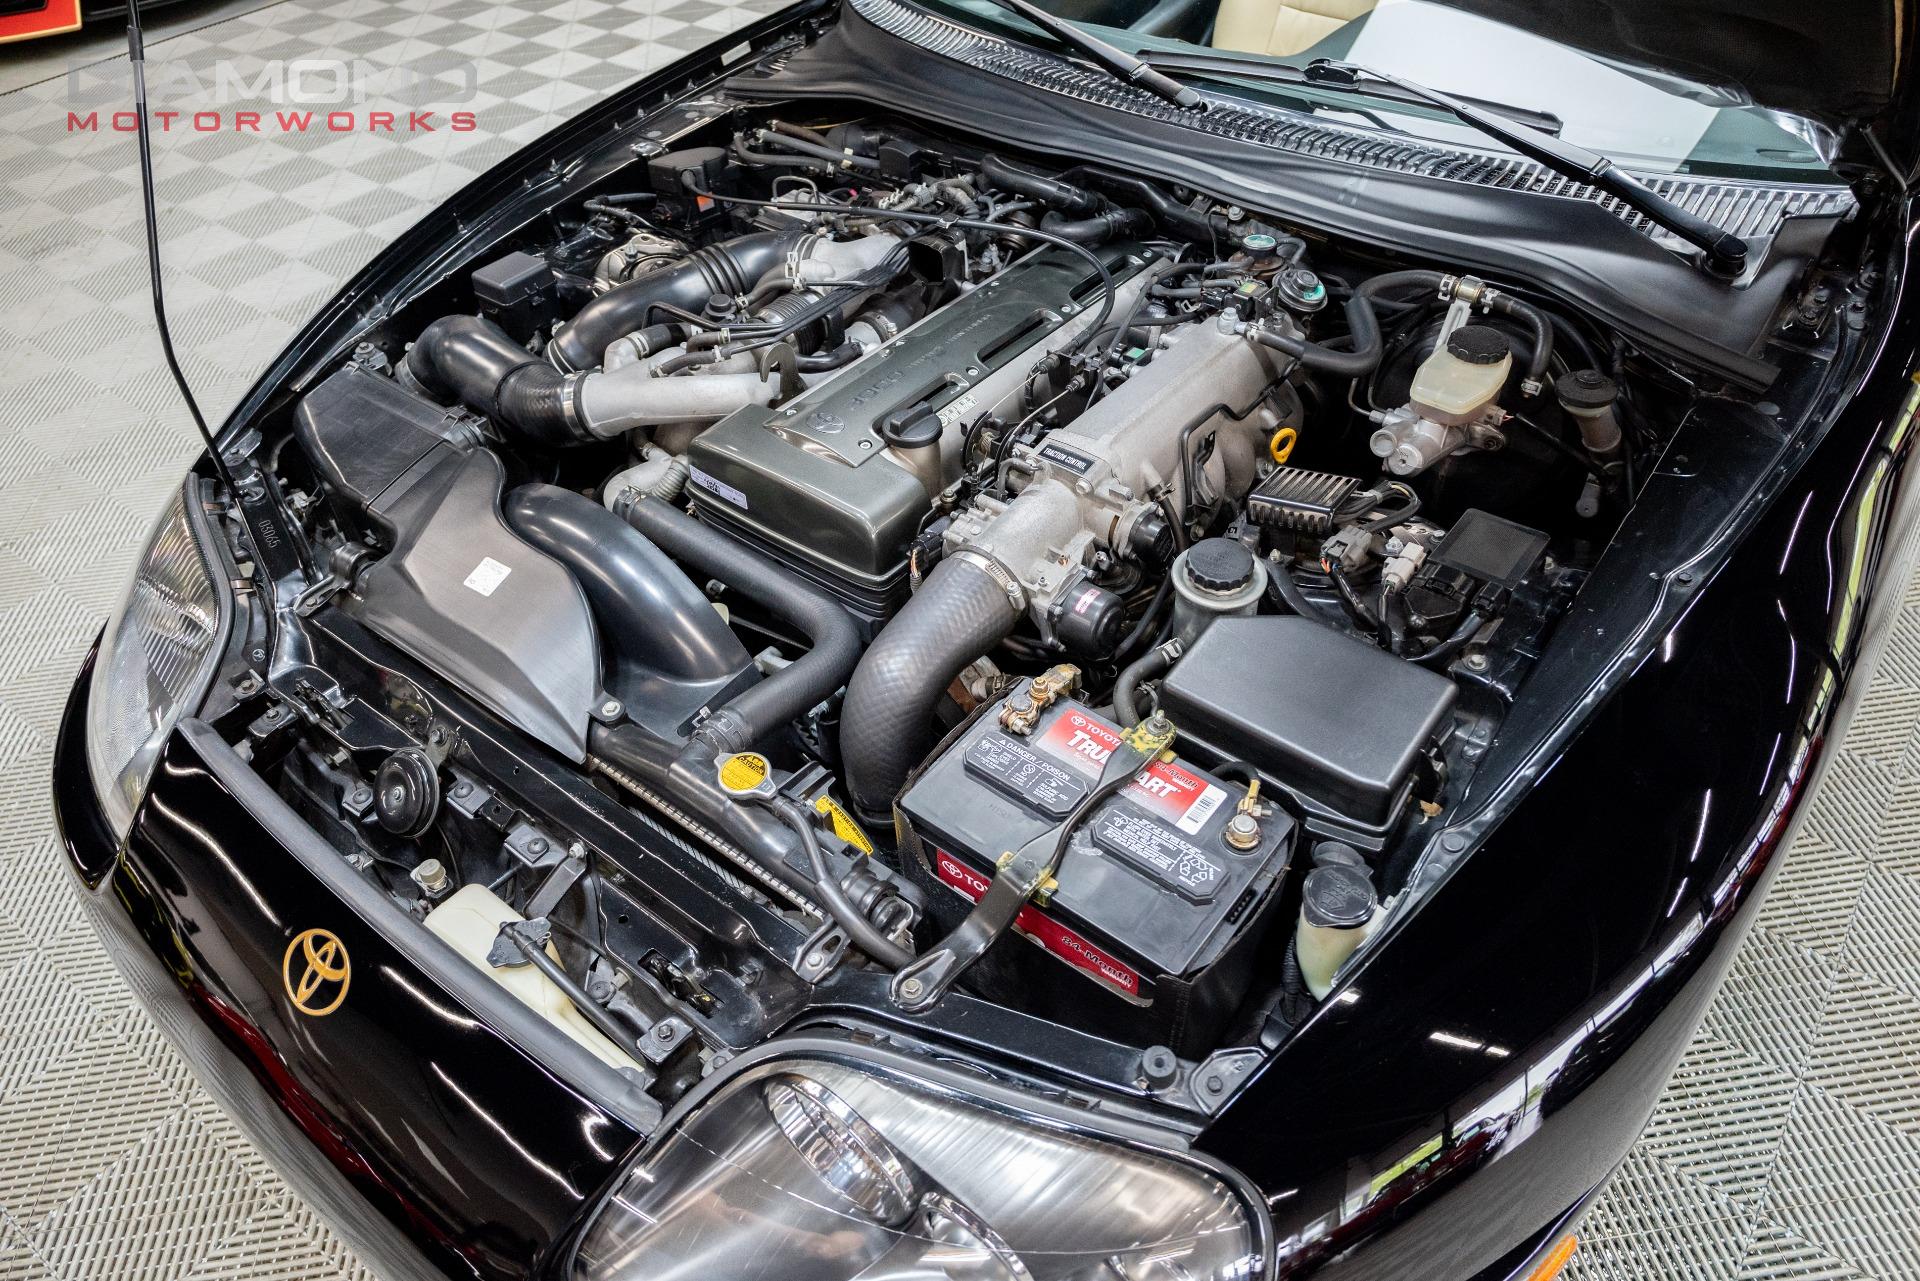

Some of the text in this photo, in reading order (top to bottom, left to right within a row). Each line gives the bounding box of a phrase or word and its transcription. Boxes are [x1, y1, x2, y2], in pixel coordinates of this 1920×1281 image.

[1043, 447, 1087, 470] TRACTION CONTROL
[739, 756, 765, 776] CAUTION
[1006, 742, 1036, 761] DANGER
[1041, 762, 1070, 780] POISON
[1061, 935, 1133, 986] 84-Month
